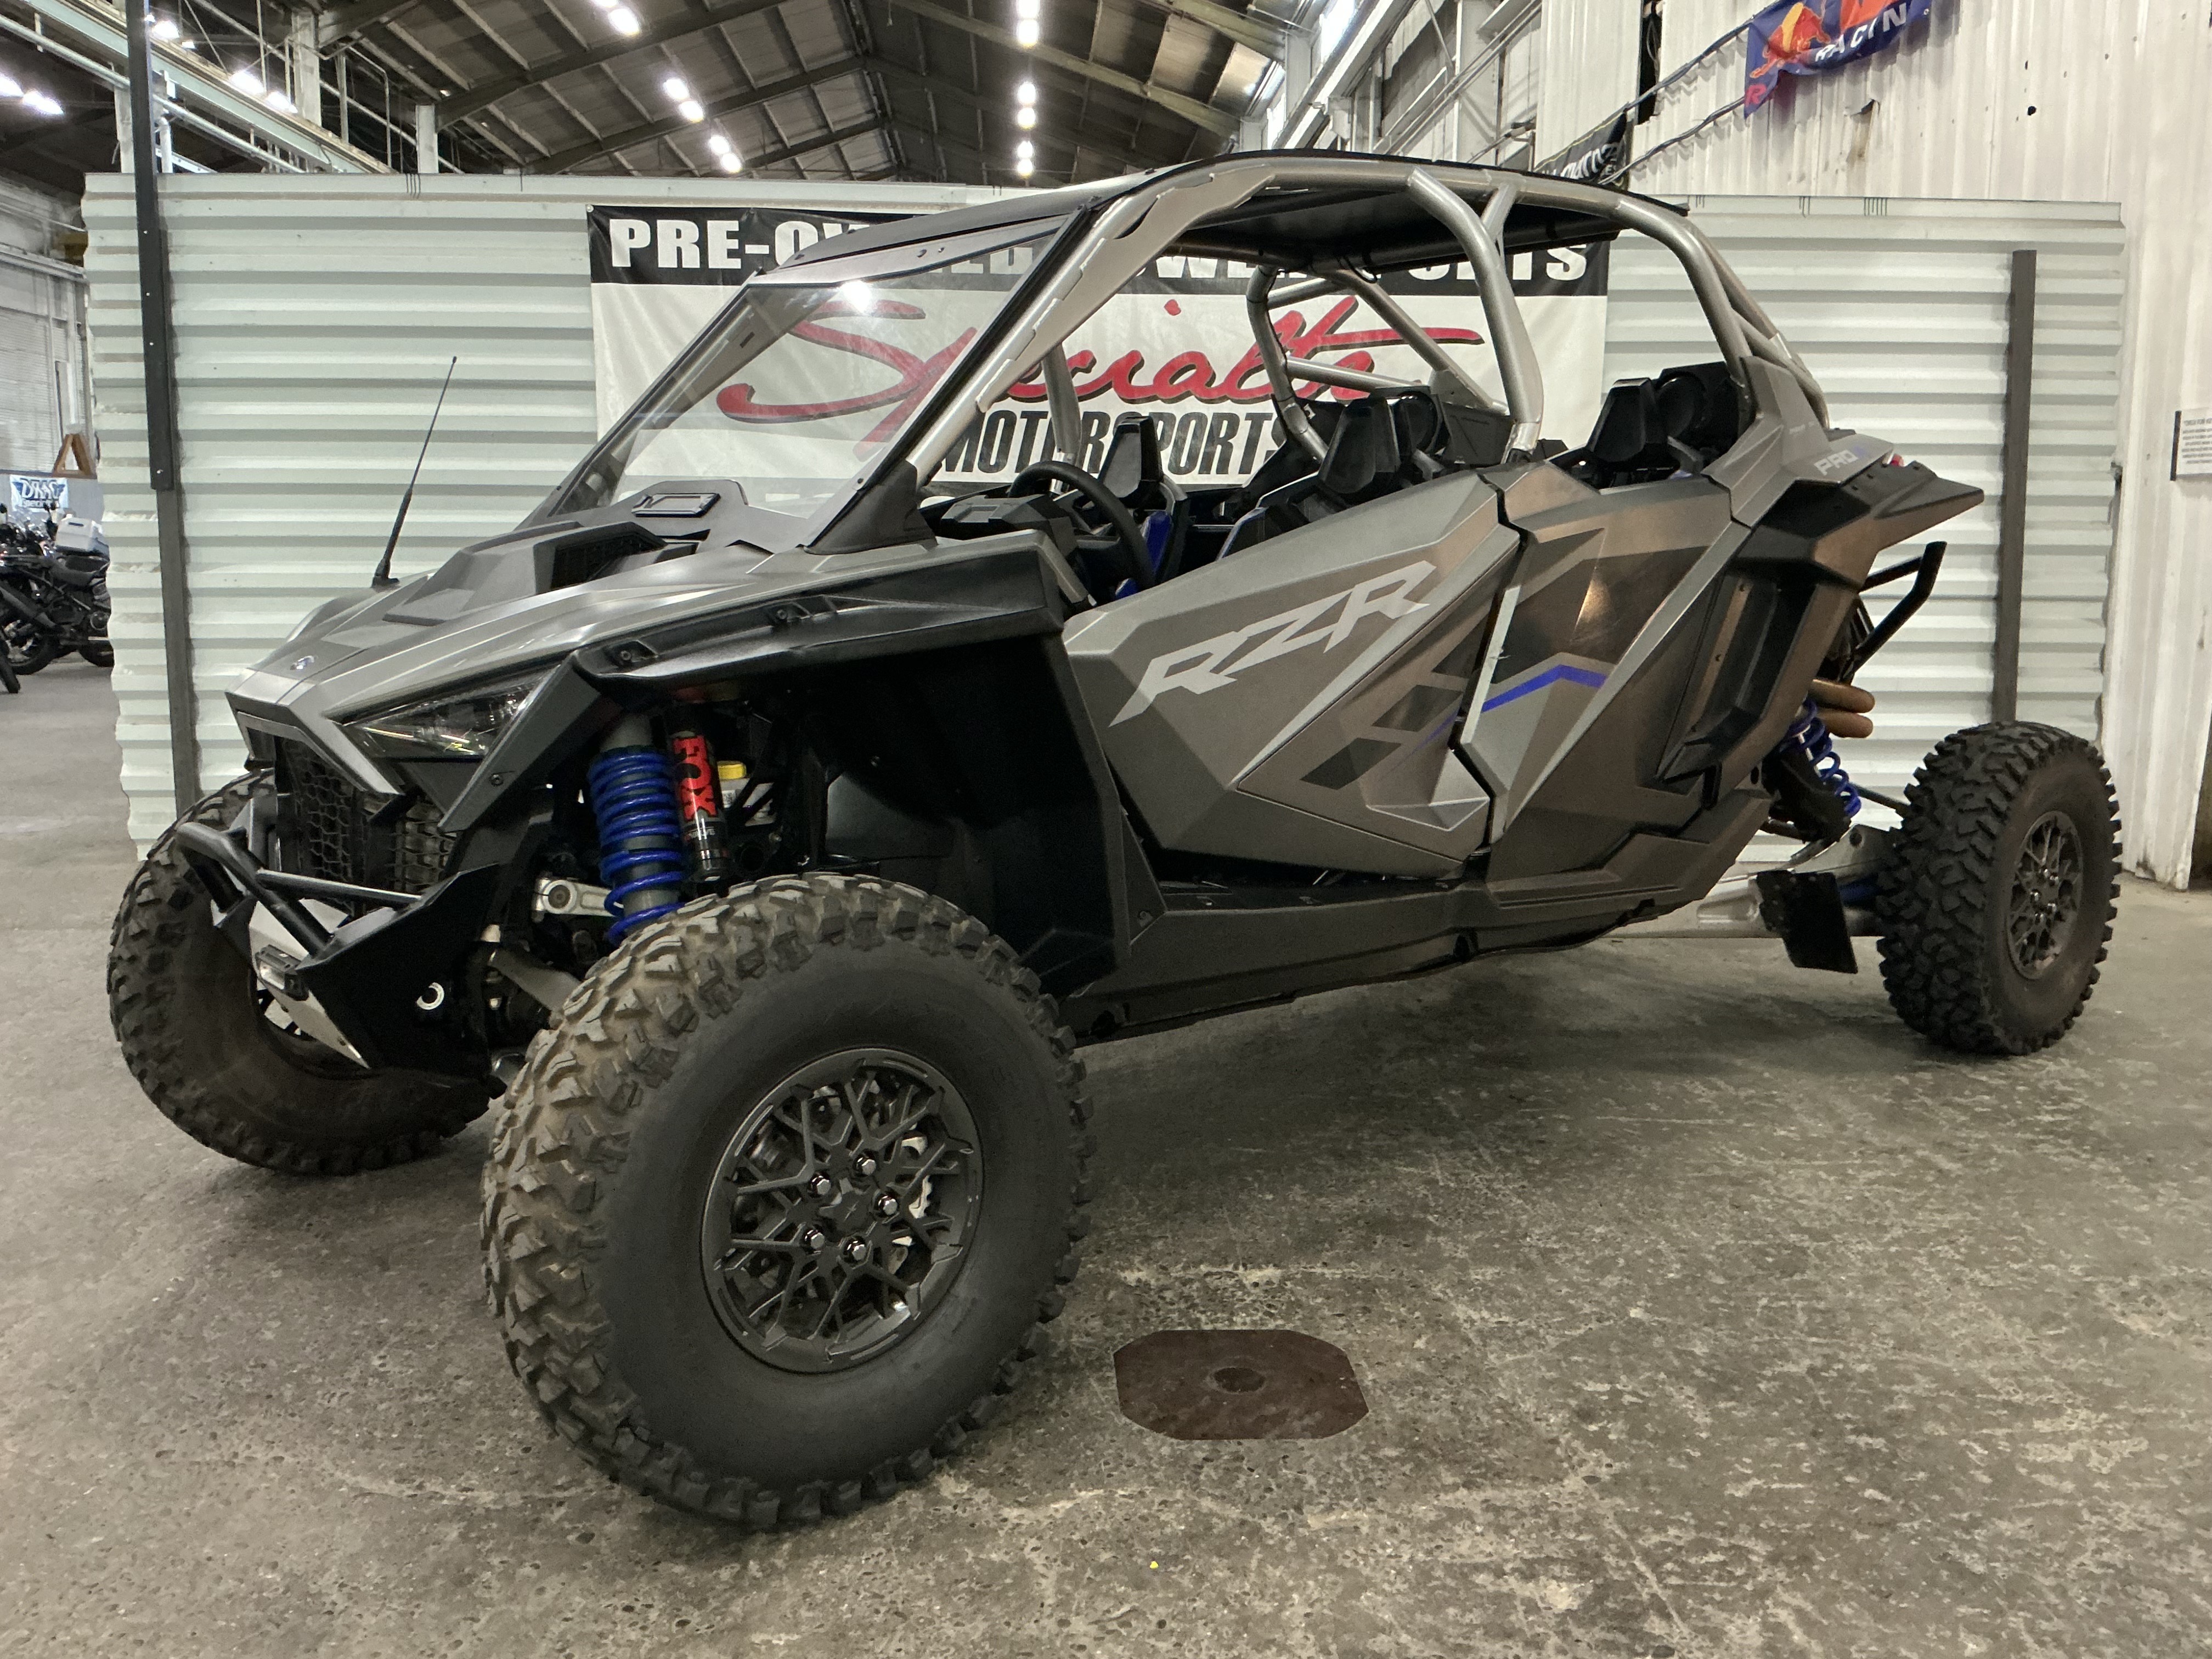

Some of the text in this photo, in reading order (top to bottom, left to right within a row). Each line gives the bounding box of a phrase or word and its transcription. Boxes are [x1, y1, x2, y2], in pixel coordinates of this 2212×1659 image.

[945, 410, 1286, 476] MOTRPORT
[1814, 450, 1859, 476] PRO
[1109, 560, 1437, 727] RZR
[672, 735, 718, 822] FOX
